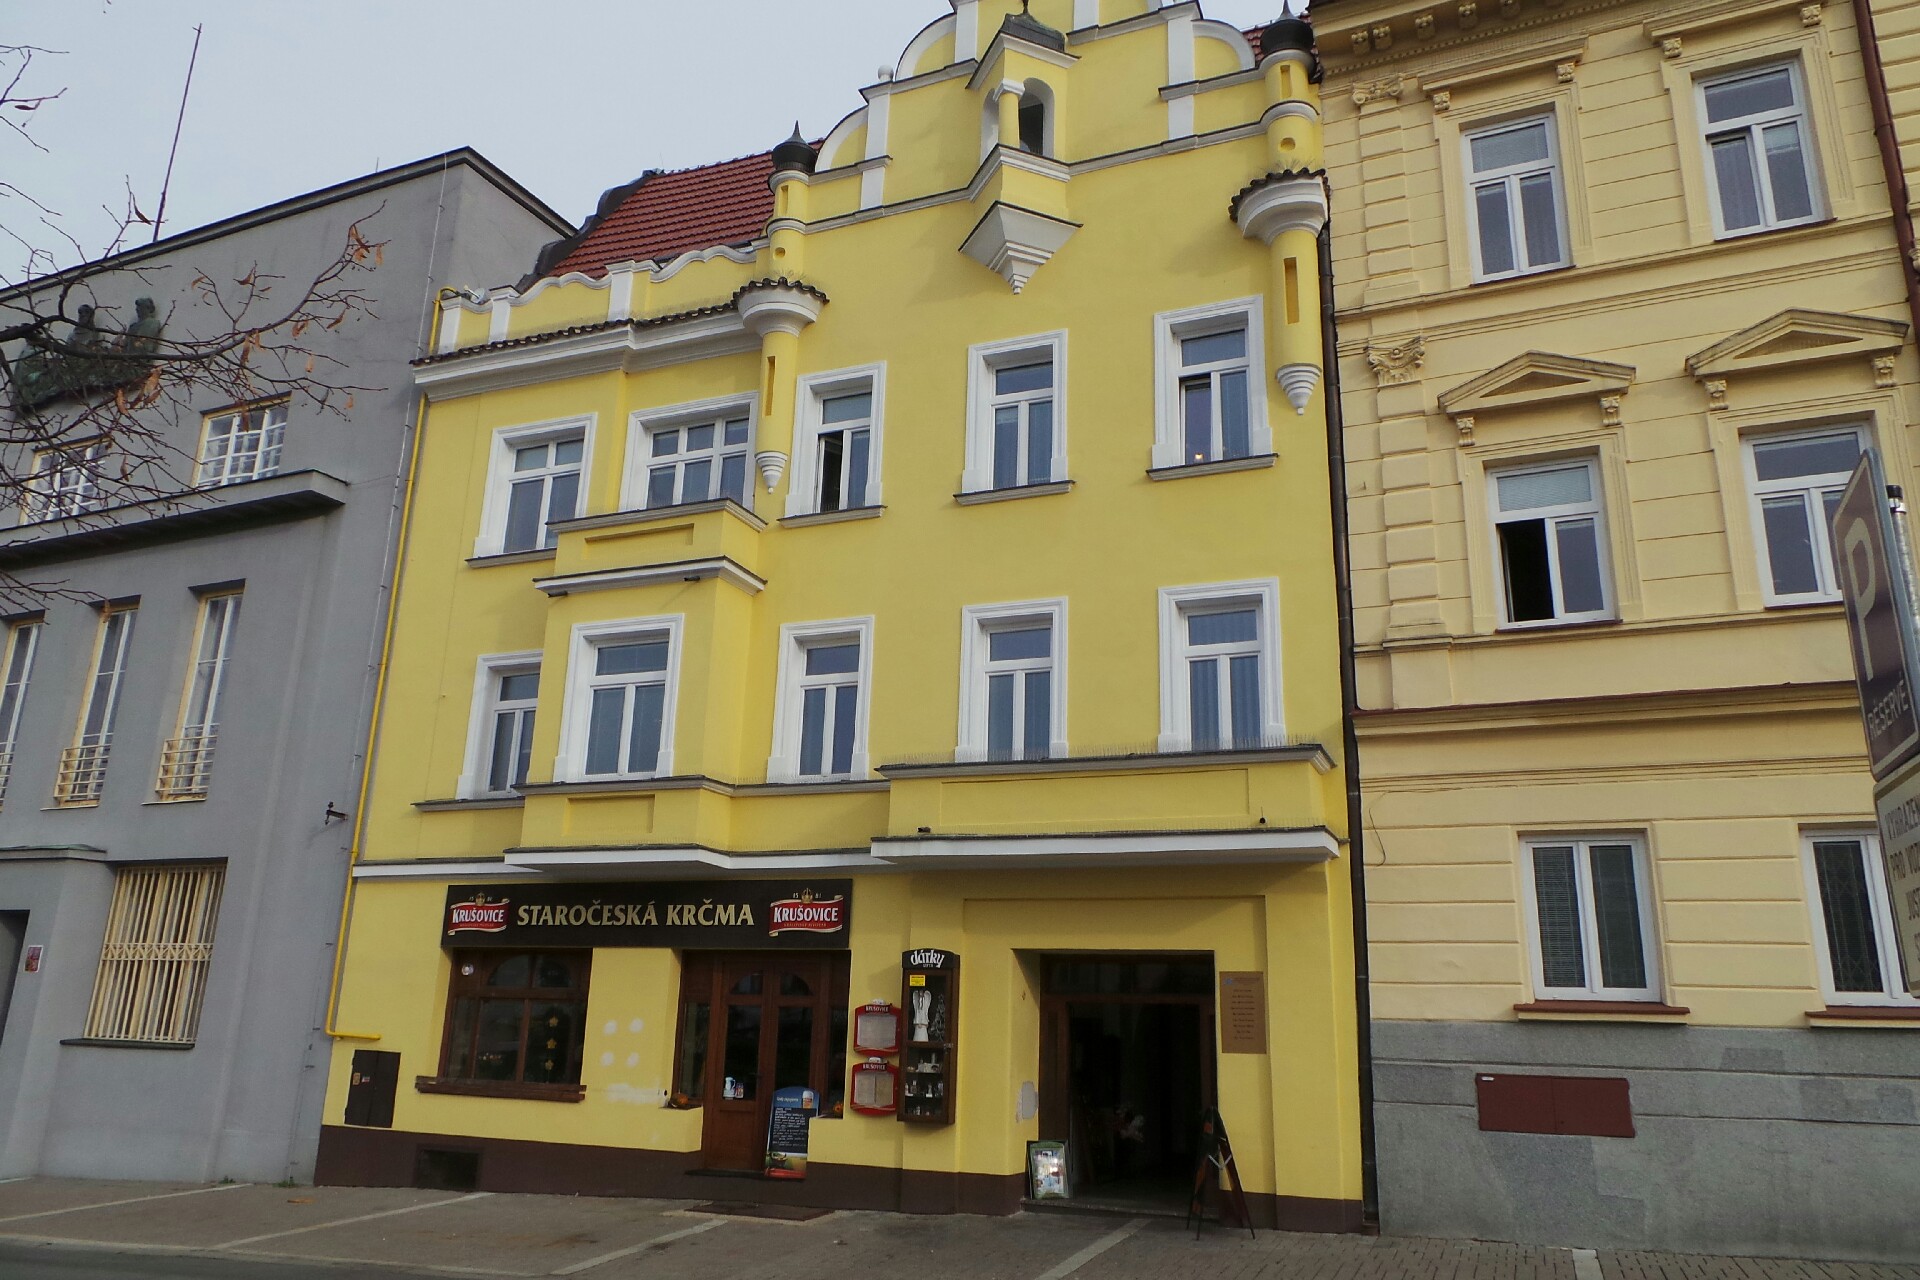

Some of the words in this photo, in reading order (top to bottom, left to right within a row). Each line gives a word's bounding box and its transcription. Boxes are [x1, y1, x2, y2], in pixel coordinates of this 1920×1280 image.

[1845, 518, 1876, 681] P
[452, 907, 504, 923] KRUŠOVICE
[517, 900, 658, 925] STAROČESKÁ
[666, 899, 754, 925] KRČMA
[774, 905, 838, 922] KRUŠOVICE
[911, 950, 945, 968] dárky
